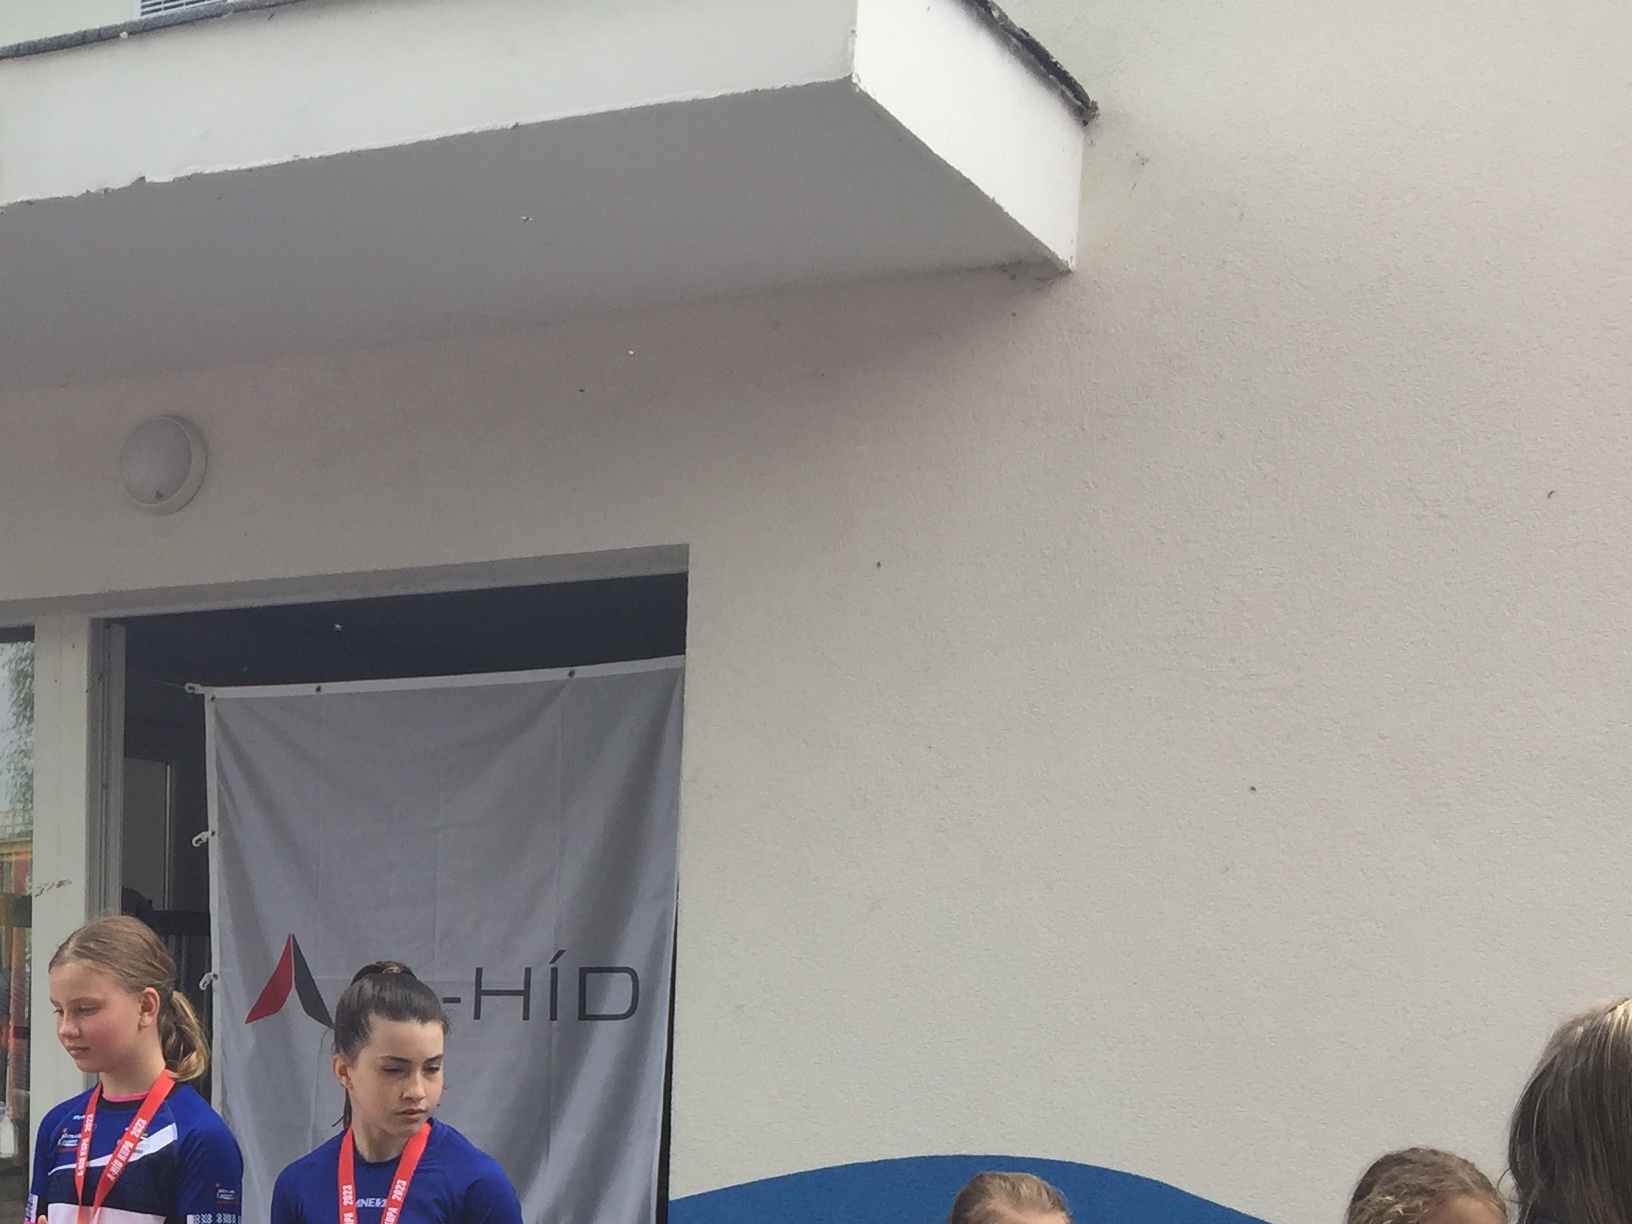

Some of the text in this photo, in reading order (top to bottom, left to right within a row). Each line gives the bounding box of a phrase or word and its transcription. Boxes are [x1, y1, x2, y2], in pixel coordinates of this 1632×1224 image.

[442, 949, 640, 1022] -HÍD
[342, 1184, 353, 1206] 2023
[392, 1179, 407, 1202] 2023
